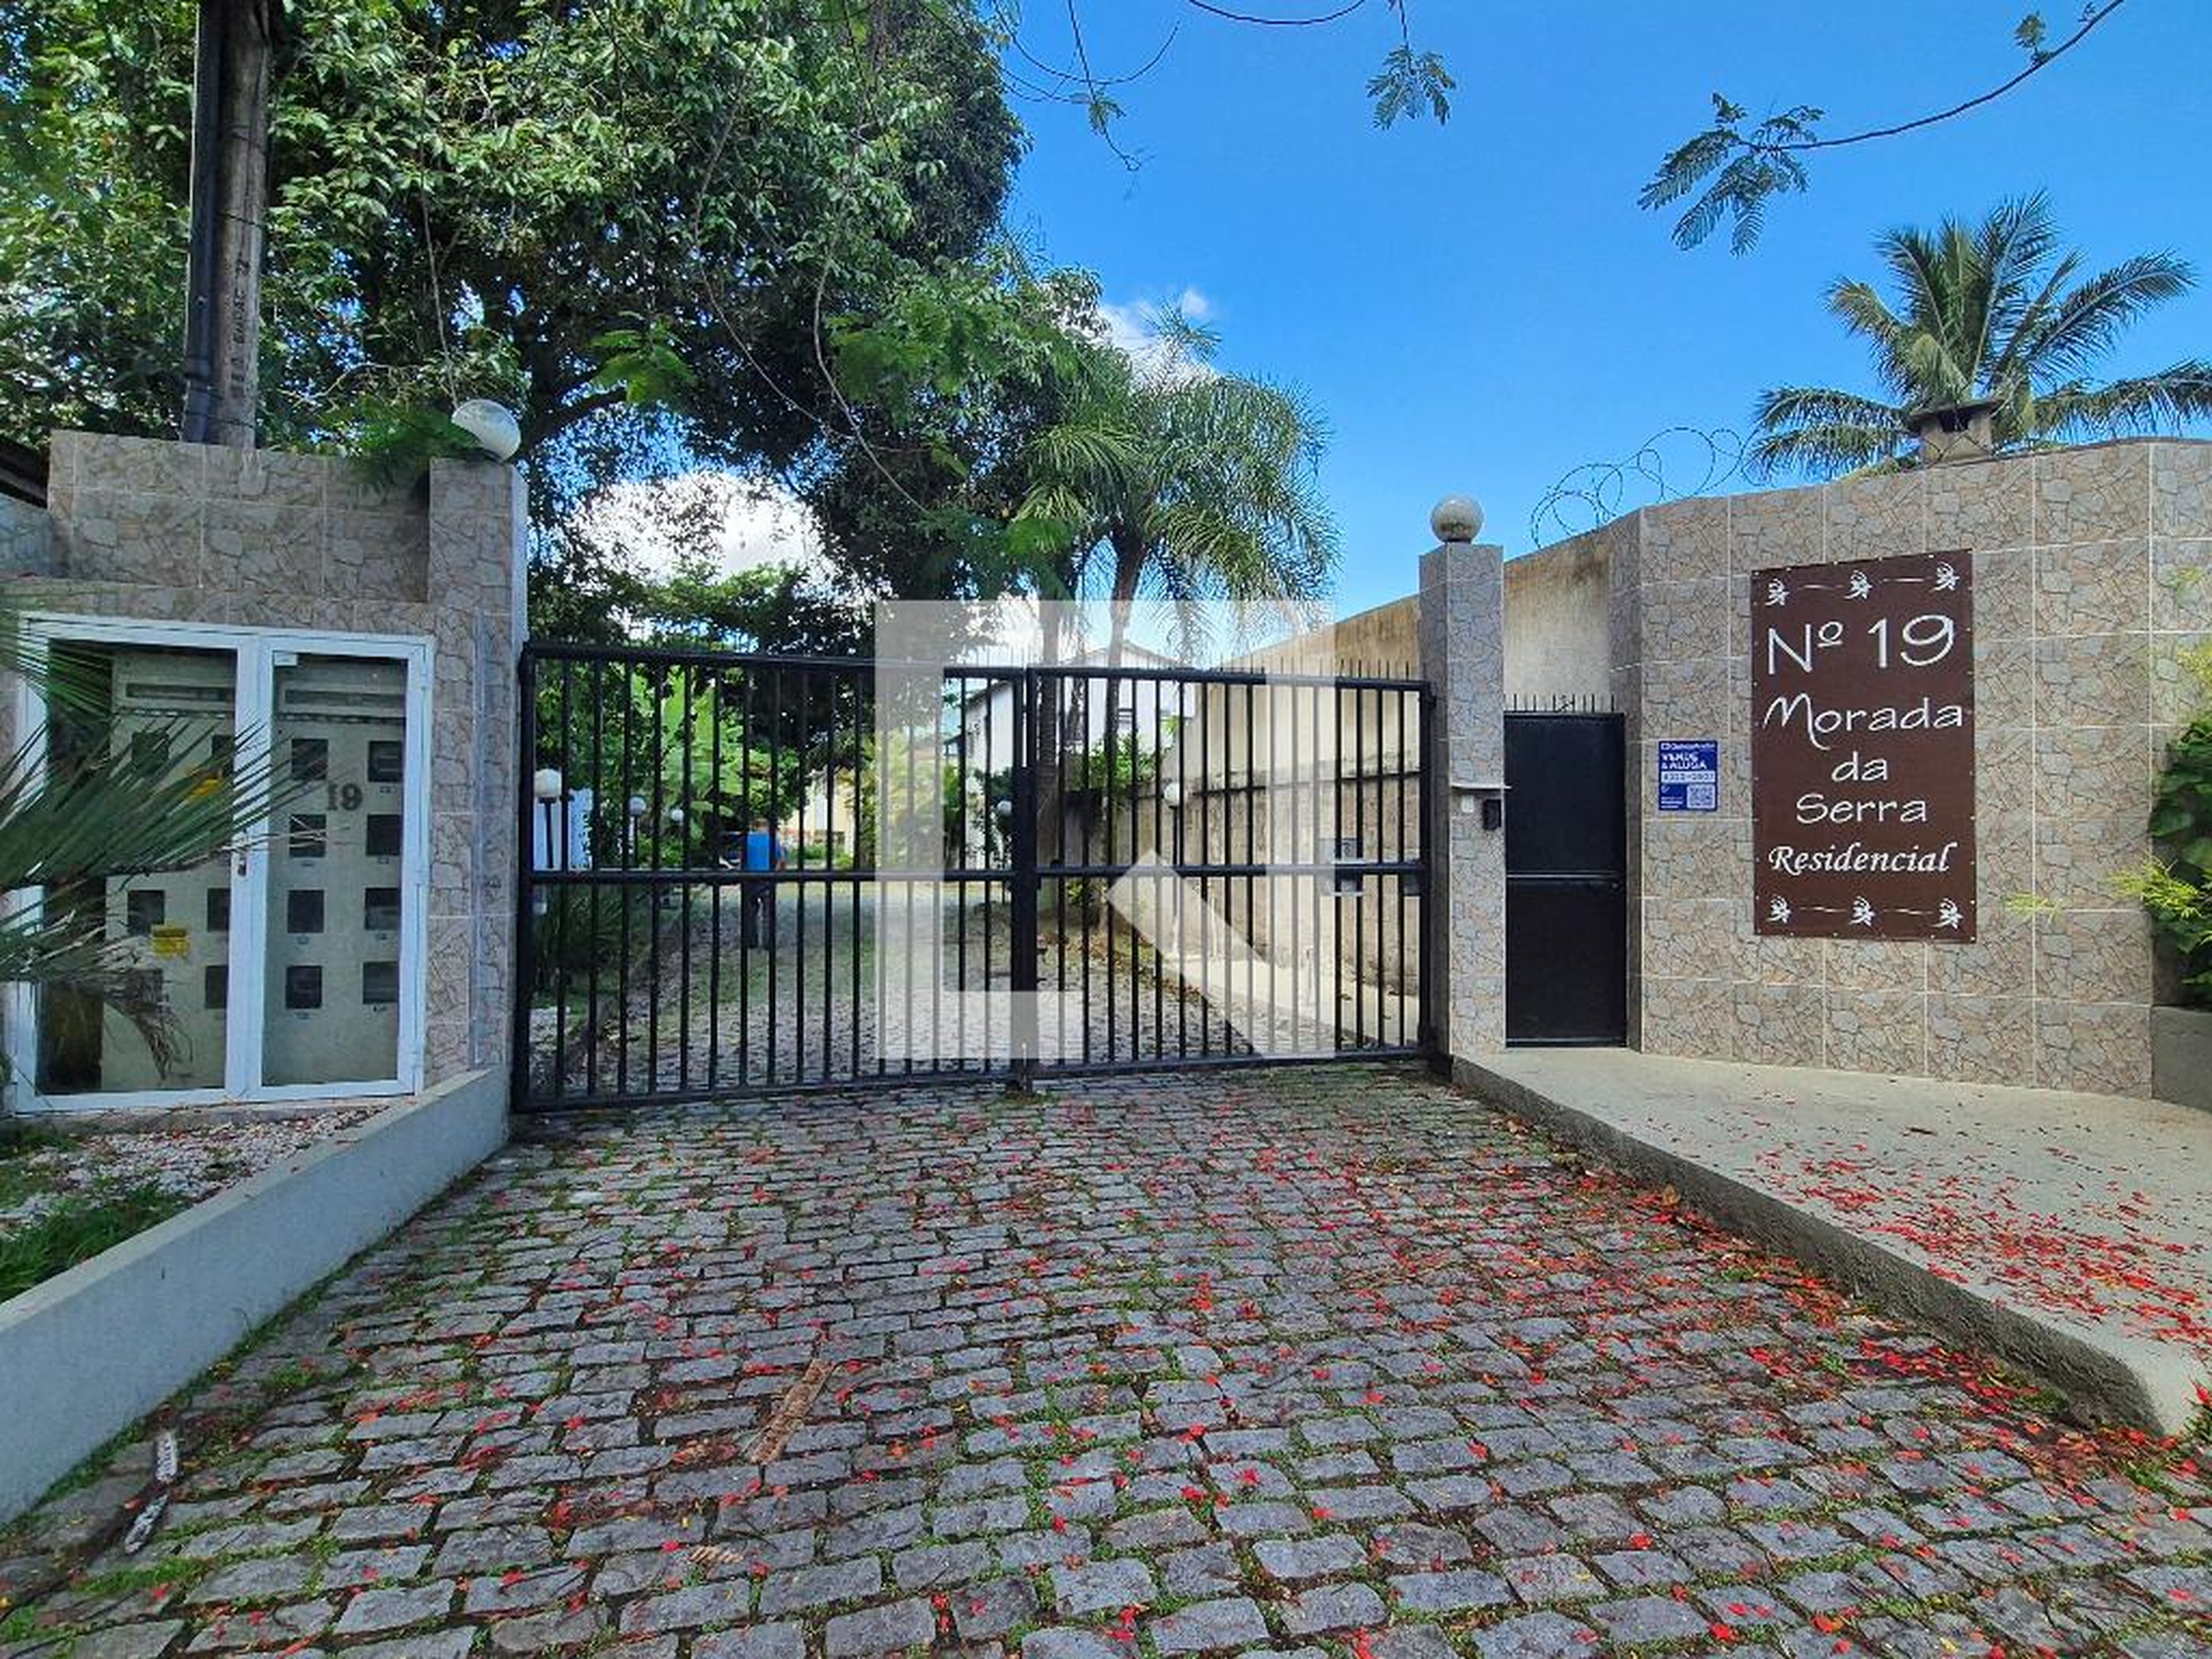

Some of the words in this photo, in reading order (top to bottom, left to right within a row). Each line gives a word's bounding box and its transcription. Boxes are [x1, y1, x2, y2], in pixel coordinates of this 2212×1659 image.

[1768, 622, 1843, 675] Nº
[1868, 614, 1954, 668] 19
[1763, 693, 1962, 750] Morada
[1832, 752, 1887, 781] da
[326, 783, 363, 812] 19
[1796, 793, 1926, 824] Serra
[1768, 843, 1957, 875] Residencial
